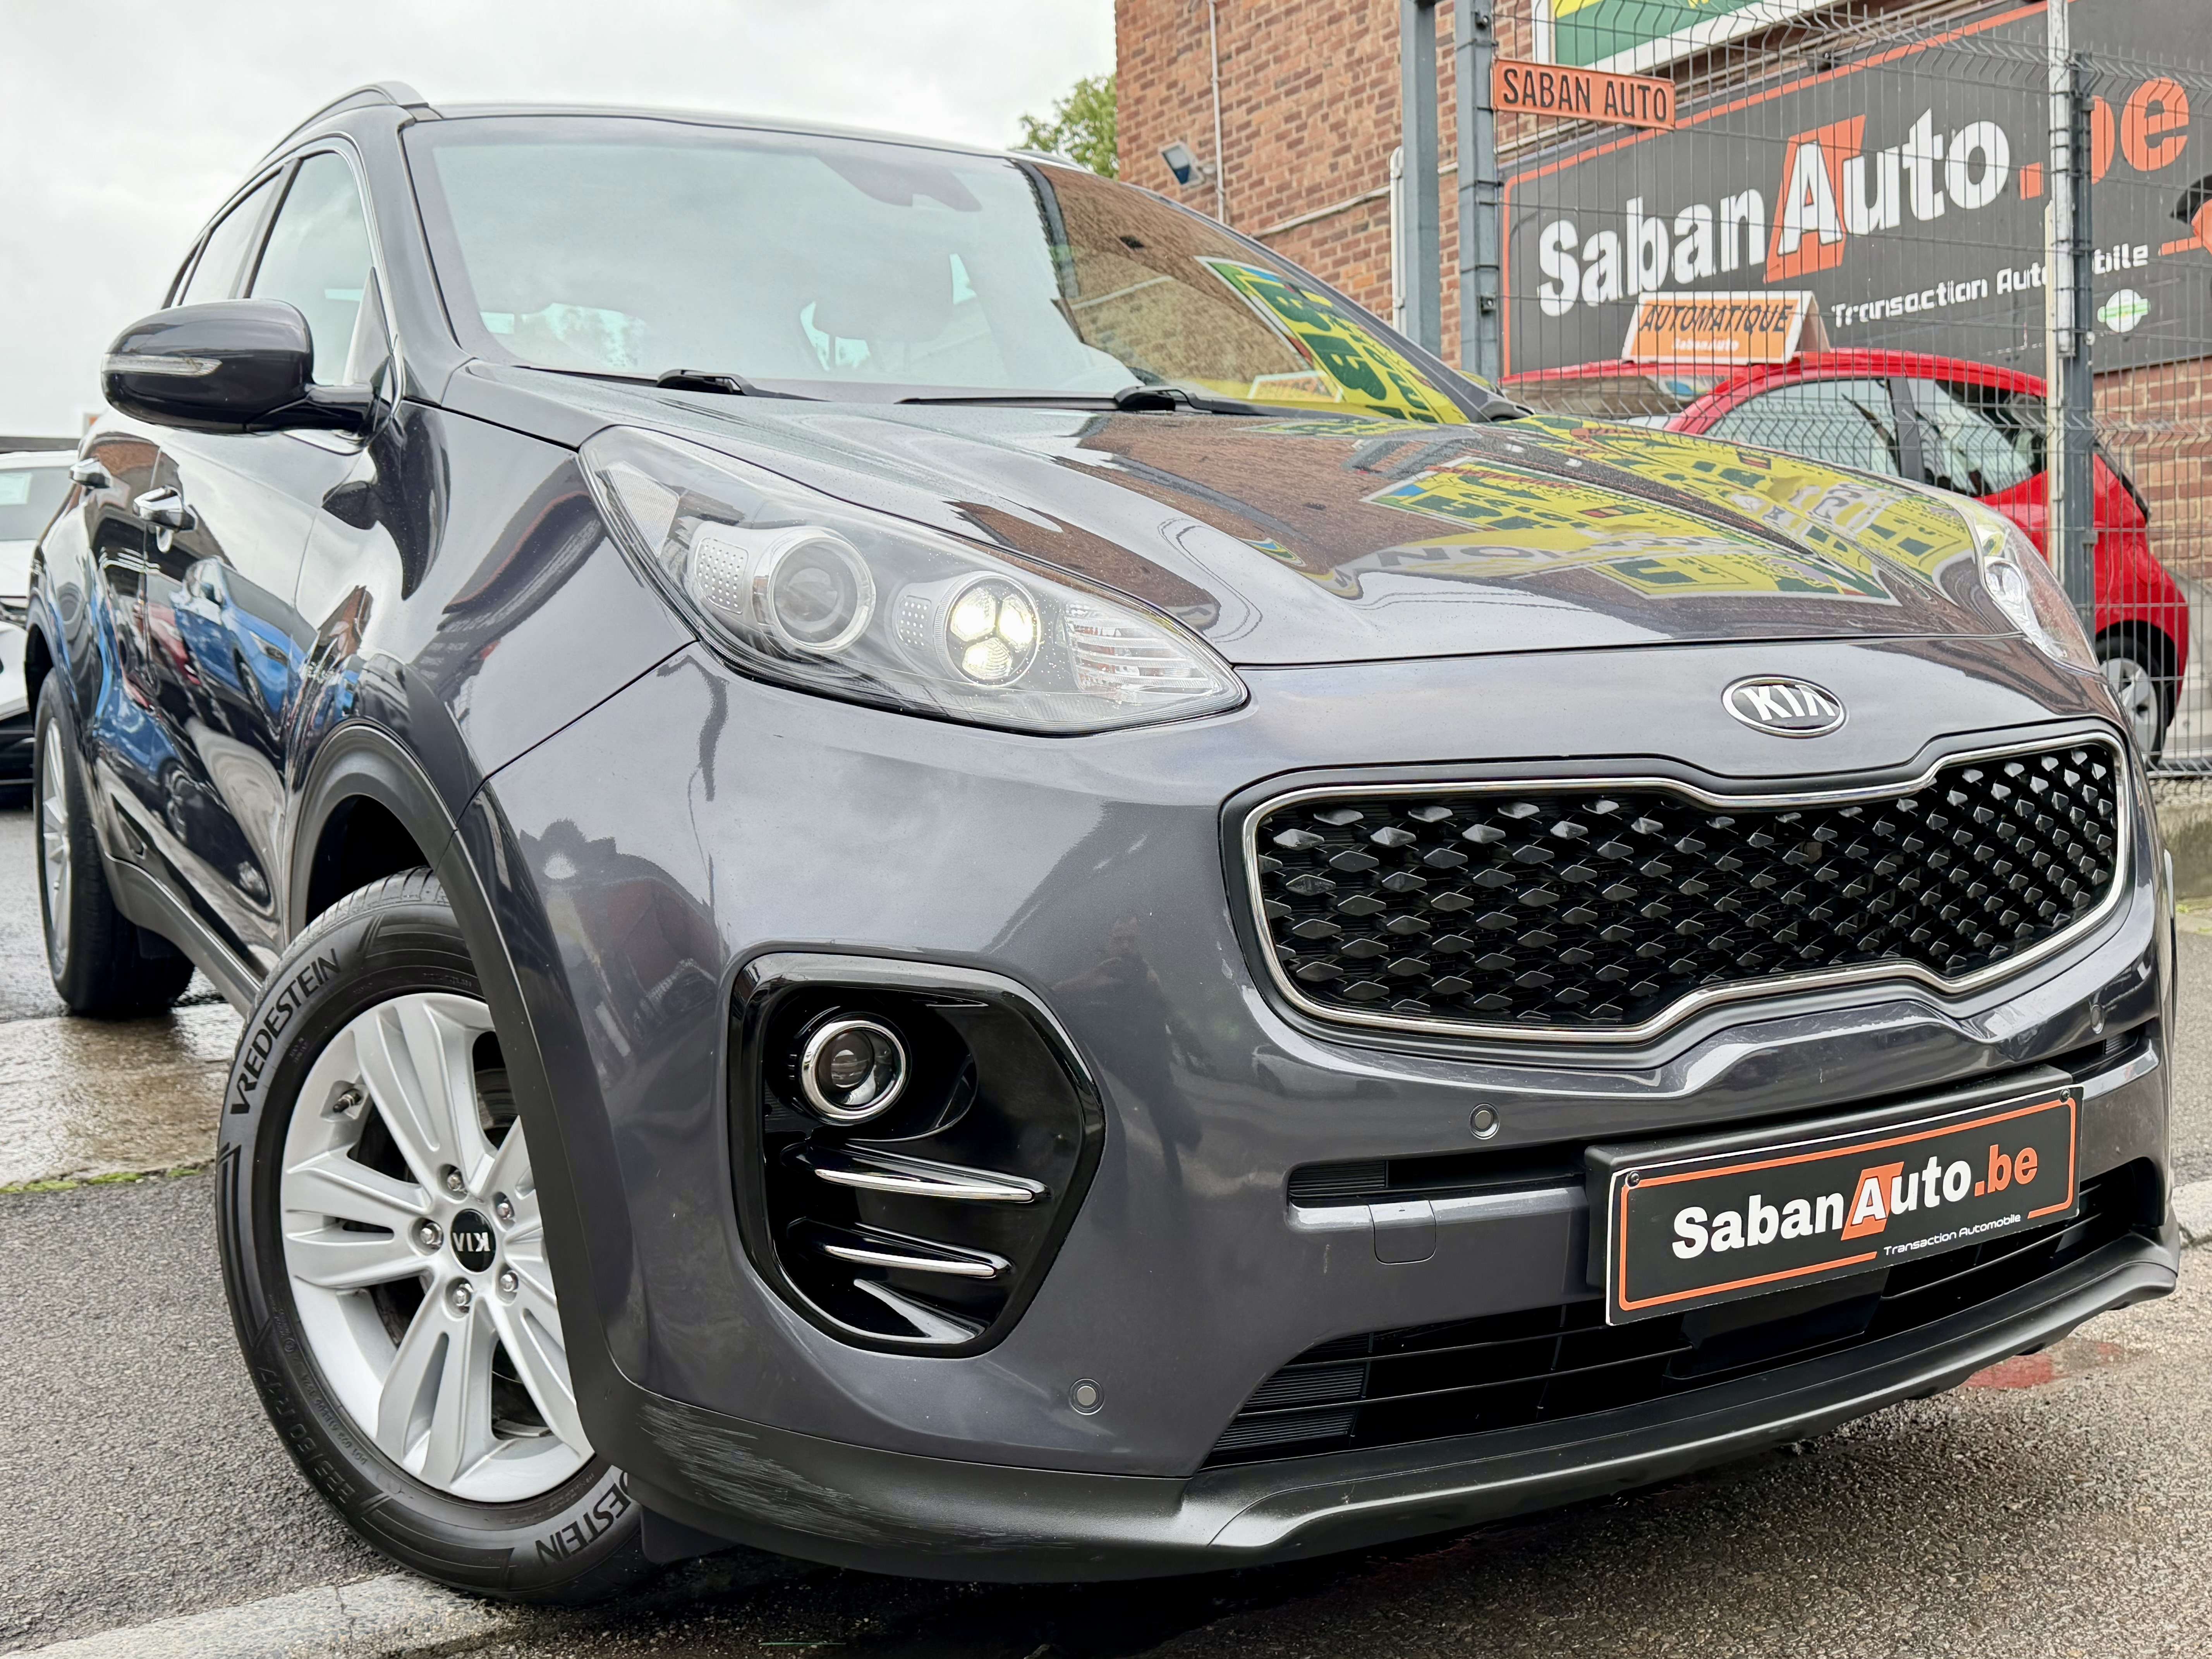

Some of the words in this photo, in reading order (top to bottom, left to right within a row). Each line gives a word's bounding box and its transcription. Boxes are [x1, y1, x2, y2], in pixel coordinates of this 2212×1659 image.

[1503, 68, 1591, 113] SABAN
[1604, 80, 1667, 122] AUTO
[1639, 304, 1793, 335] AUTOMATIQUE
[1831, 278, 1988, 329] Transaction
[1739, 685, 1836, 721] KIA
[230, 948, 342, 1115] VREDESTEIN
[1671, 1144, 2039, 1259] SabanAuto.be
[452, 1232, 491, 1252] KIA
[1883, 1231, 1957, 1257] Transaction
[1958, 1213, 2022, 1237] Automobile
